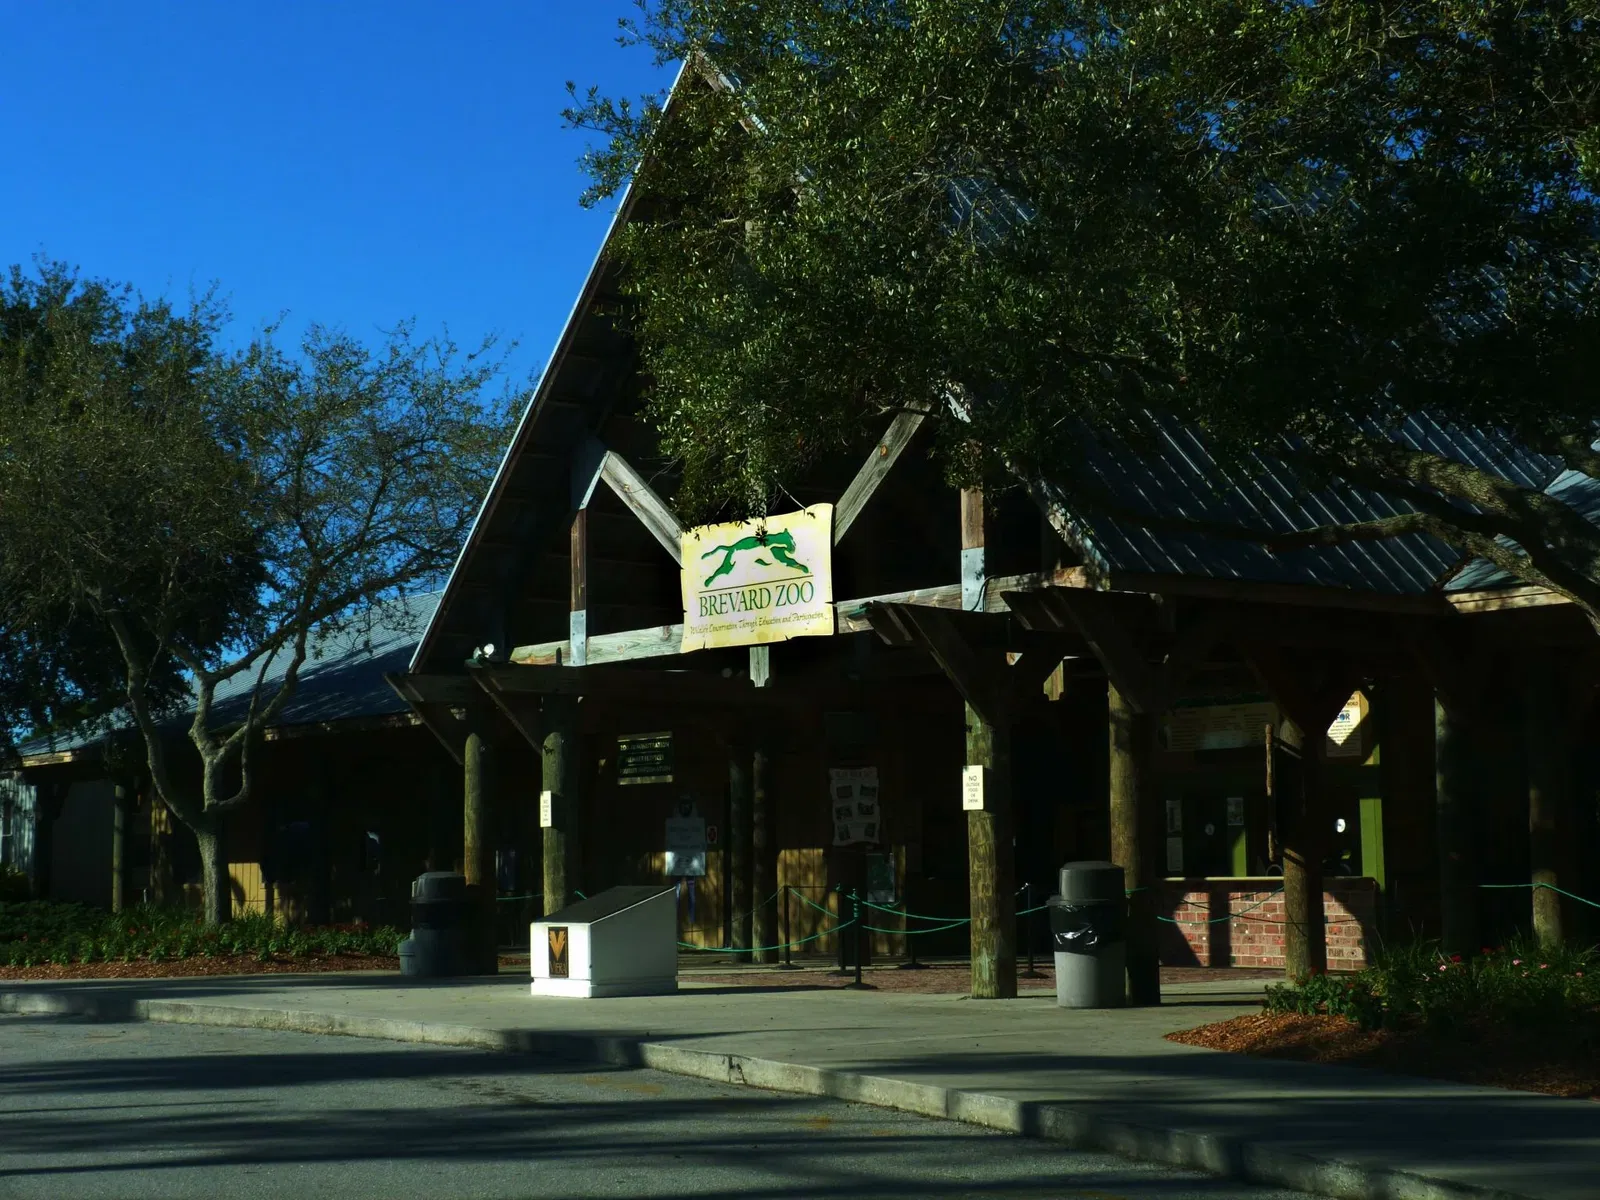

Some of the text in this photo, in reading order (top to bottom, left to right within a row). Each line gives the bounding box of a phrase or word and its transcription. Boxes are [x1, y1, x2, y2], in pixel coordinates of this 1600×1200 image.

[699, 581, 814, 617] BREVARD ZOO
[758, 615, 781, 626] Education
